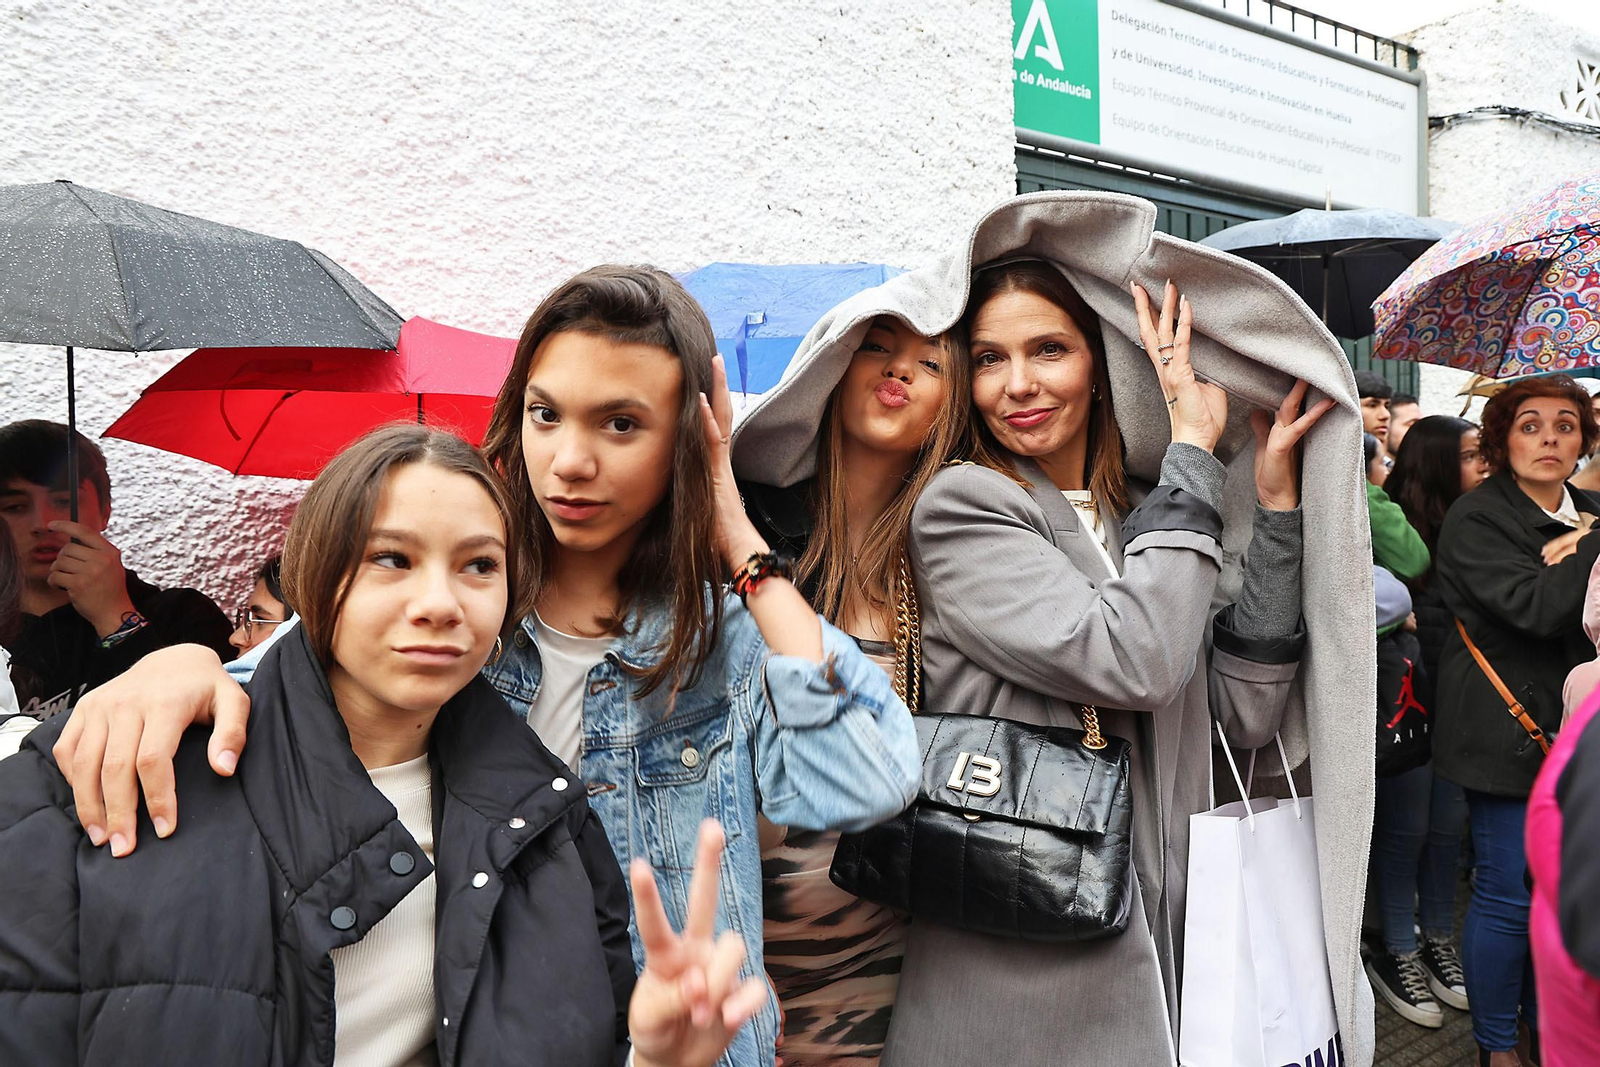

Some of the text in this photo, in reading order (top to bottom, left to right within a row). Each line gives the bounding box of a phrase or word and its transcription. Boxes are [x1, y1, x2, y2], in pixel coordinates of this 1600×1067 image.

[1111, 9, 1167, 36] Delegación
[1170, 27, 1216, 51] Territorial
[1219, 44, 1229, 55] de
[1020, 69, 1034, 85] de
[1036, 73, 1092, 100] Andalucía
[1112, 47, 1118, 59] y
[1120, 48, 1133, 60] de
[1136, 52, 1196, 80] Universidad,
[1198, 70, 1258, 96] Investigación
[1112, 78, 1146, 97] Equipo
[1148, 86, 1182, 106] Técnico
[1184, 97, 1226, 118] Provincial
[1112, 112, 1146, 132] Equipo
[1148, 122, 1160, 134] de
[1162, 125, 1214, 148] Orientación
